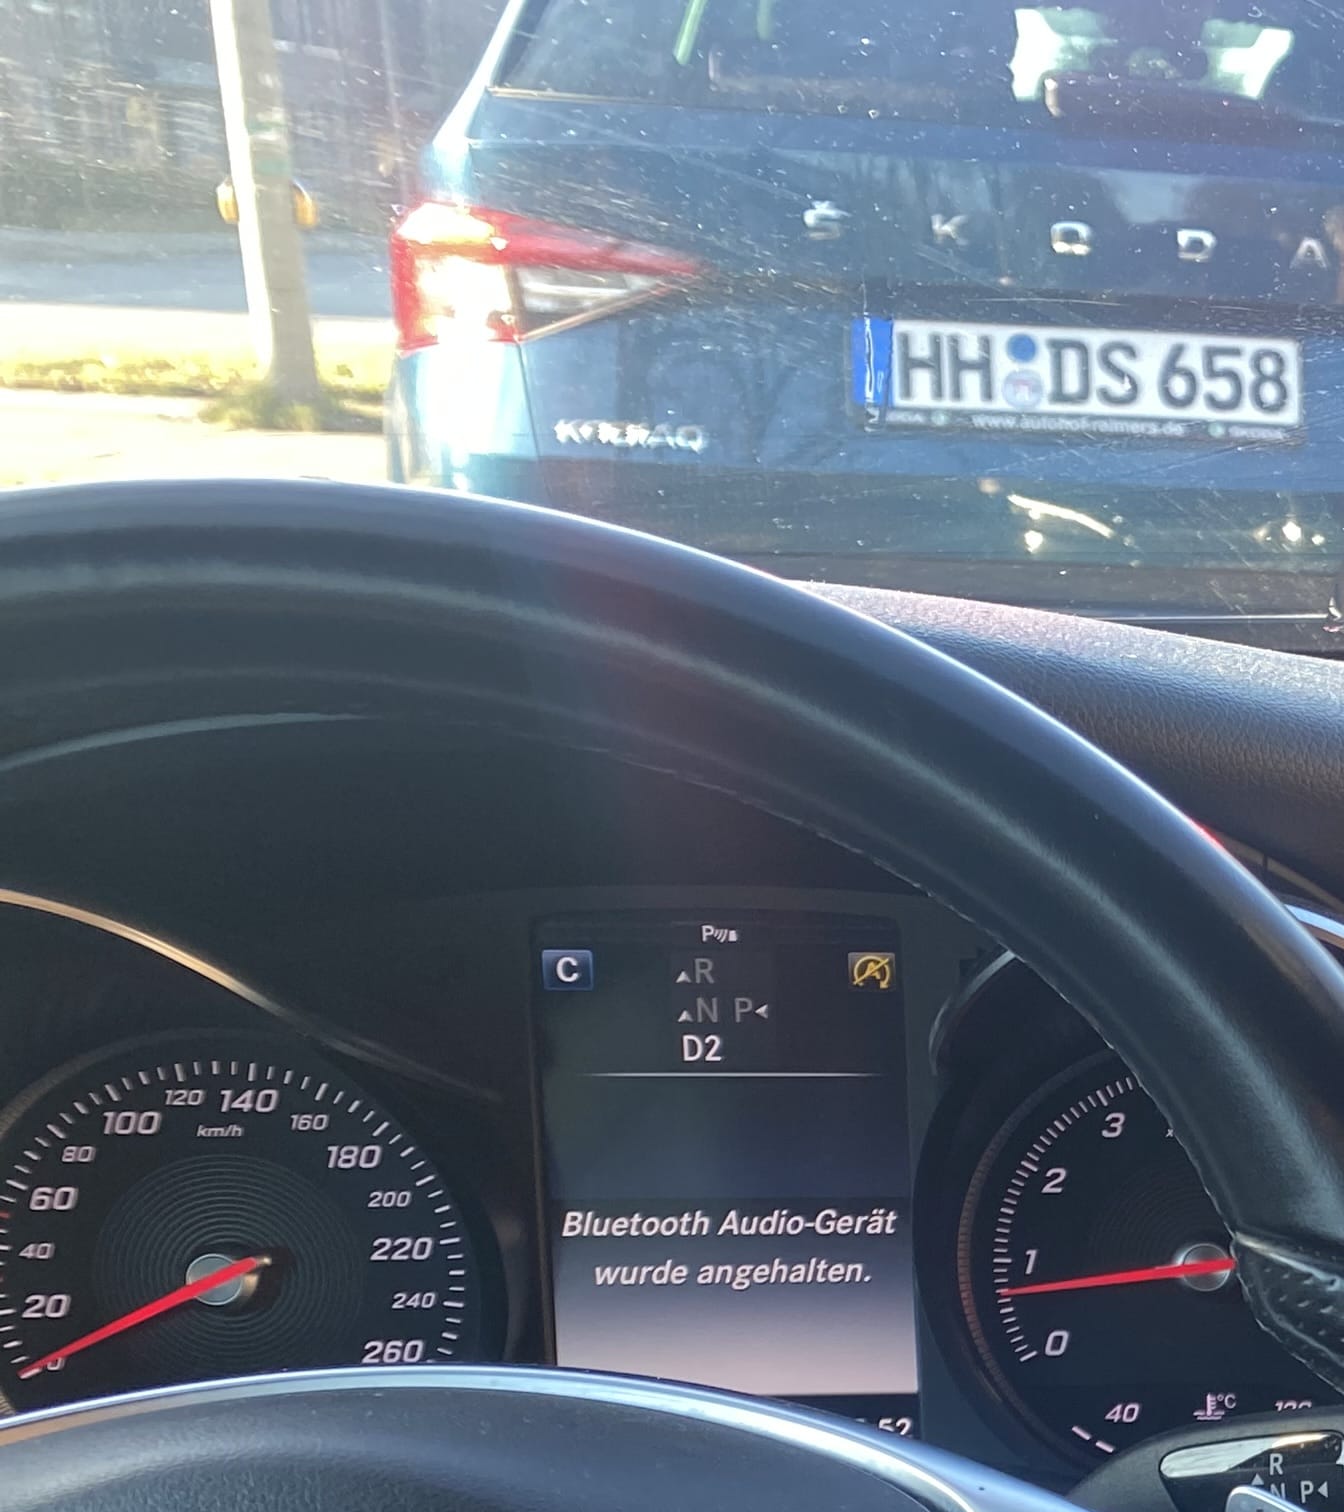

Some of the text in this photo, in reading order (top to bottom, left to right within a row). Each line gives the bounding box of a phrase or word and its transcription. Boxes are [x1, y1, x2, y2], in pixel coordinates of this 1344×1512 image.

[896, 331, 1288, 414] HH DS 658
[556, 956, 579, 983] C
[694, 958, 714, 984] R
[696, 998, 752, 1022] N P
[682, 1034, 722, 1062] D2
[165, 1089, 205, 1106] 120
[220, 1089, 279, 1114] 140
[102, 1111, 161, 1135] 100
[196, 1122, 242, 1139] km/h
[290, 1114, 328, 1131] 160
[1102, 1113, 1125, 1138] 3
[61, 1146, 95, 1162] 80
[326, 1145, 381, 1169] 180
[1041, 1168, 1067, 1193] 2
[30, 1186, 78, 1211] 60
[368, 1190, 411, 1208] 200
[562, 1208, 897, 1238] Bluetooth Audio-Gerät
[19, 1242, 54, 1259] 40
[370, 1238, 432, 1261] 220
[594, 1258, 872, 1290] wurde angehalten.
[1025, 1249, 1037, 1275] 1
[22, 1295, 69, 1319] 20
[391, 1292, 436, 1310] 240
[362, 1340, 425, 1364] 260
[1044, 1330, 1070, 1356] 0
[1105, 1404, 1141, 1423] 40
[1269, 1454, 1283, 1474] R
[1301, 1482, 1313, 1503] P
